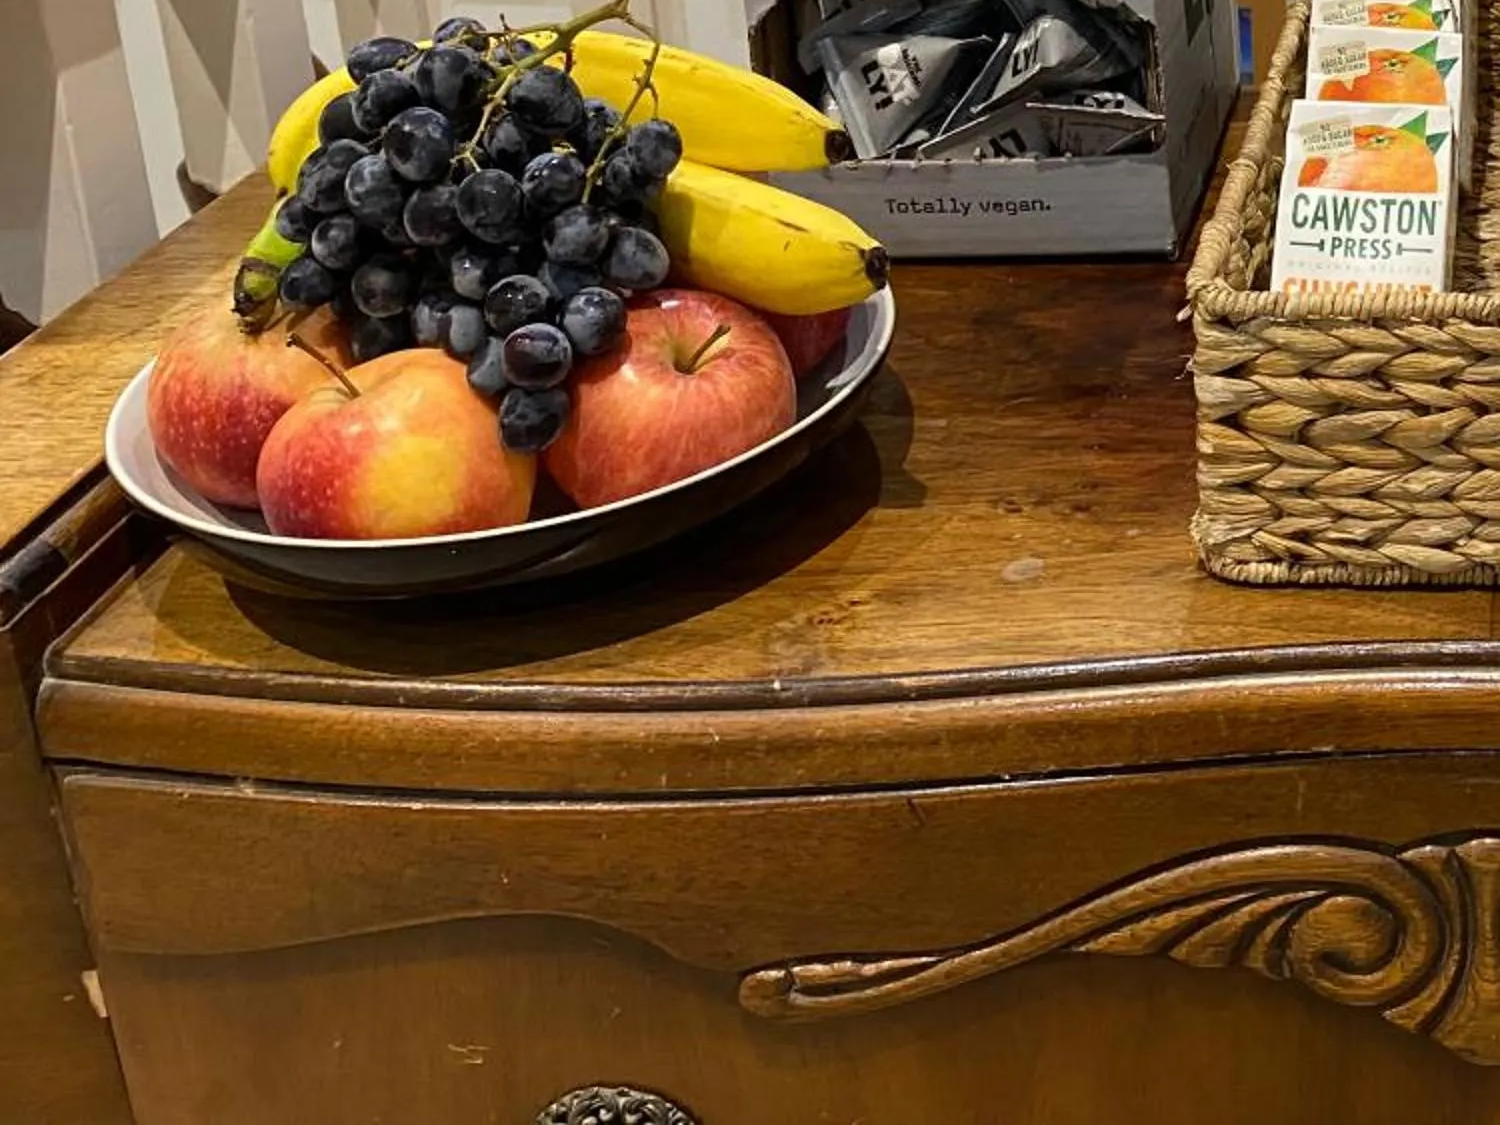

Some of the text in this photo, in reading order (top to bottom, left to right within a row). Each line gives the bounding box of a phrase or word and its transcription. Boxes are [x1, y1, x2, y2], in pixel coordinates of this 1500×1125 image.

[885, 197, 1052, 221] Totally vegan.
[1292, 192, 1437, 236] CAWSTON
[1330, 236, 1393, 260] PRESS
